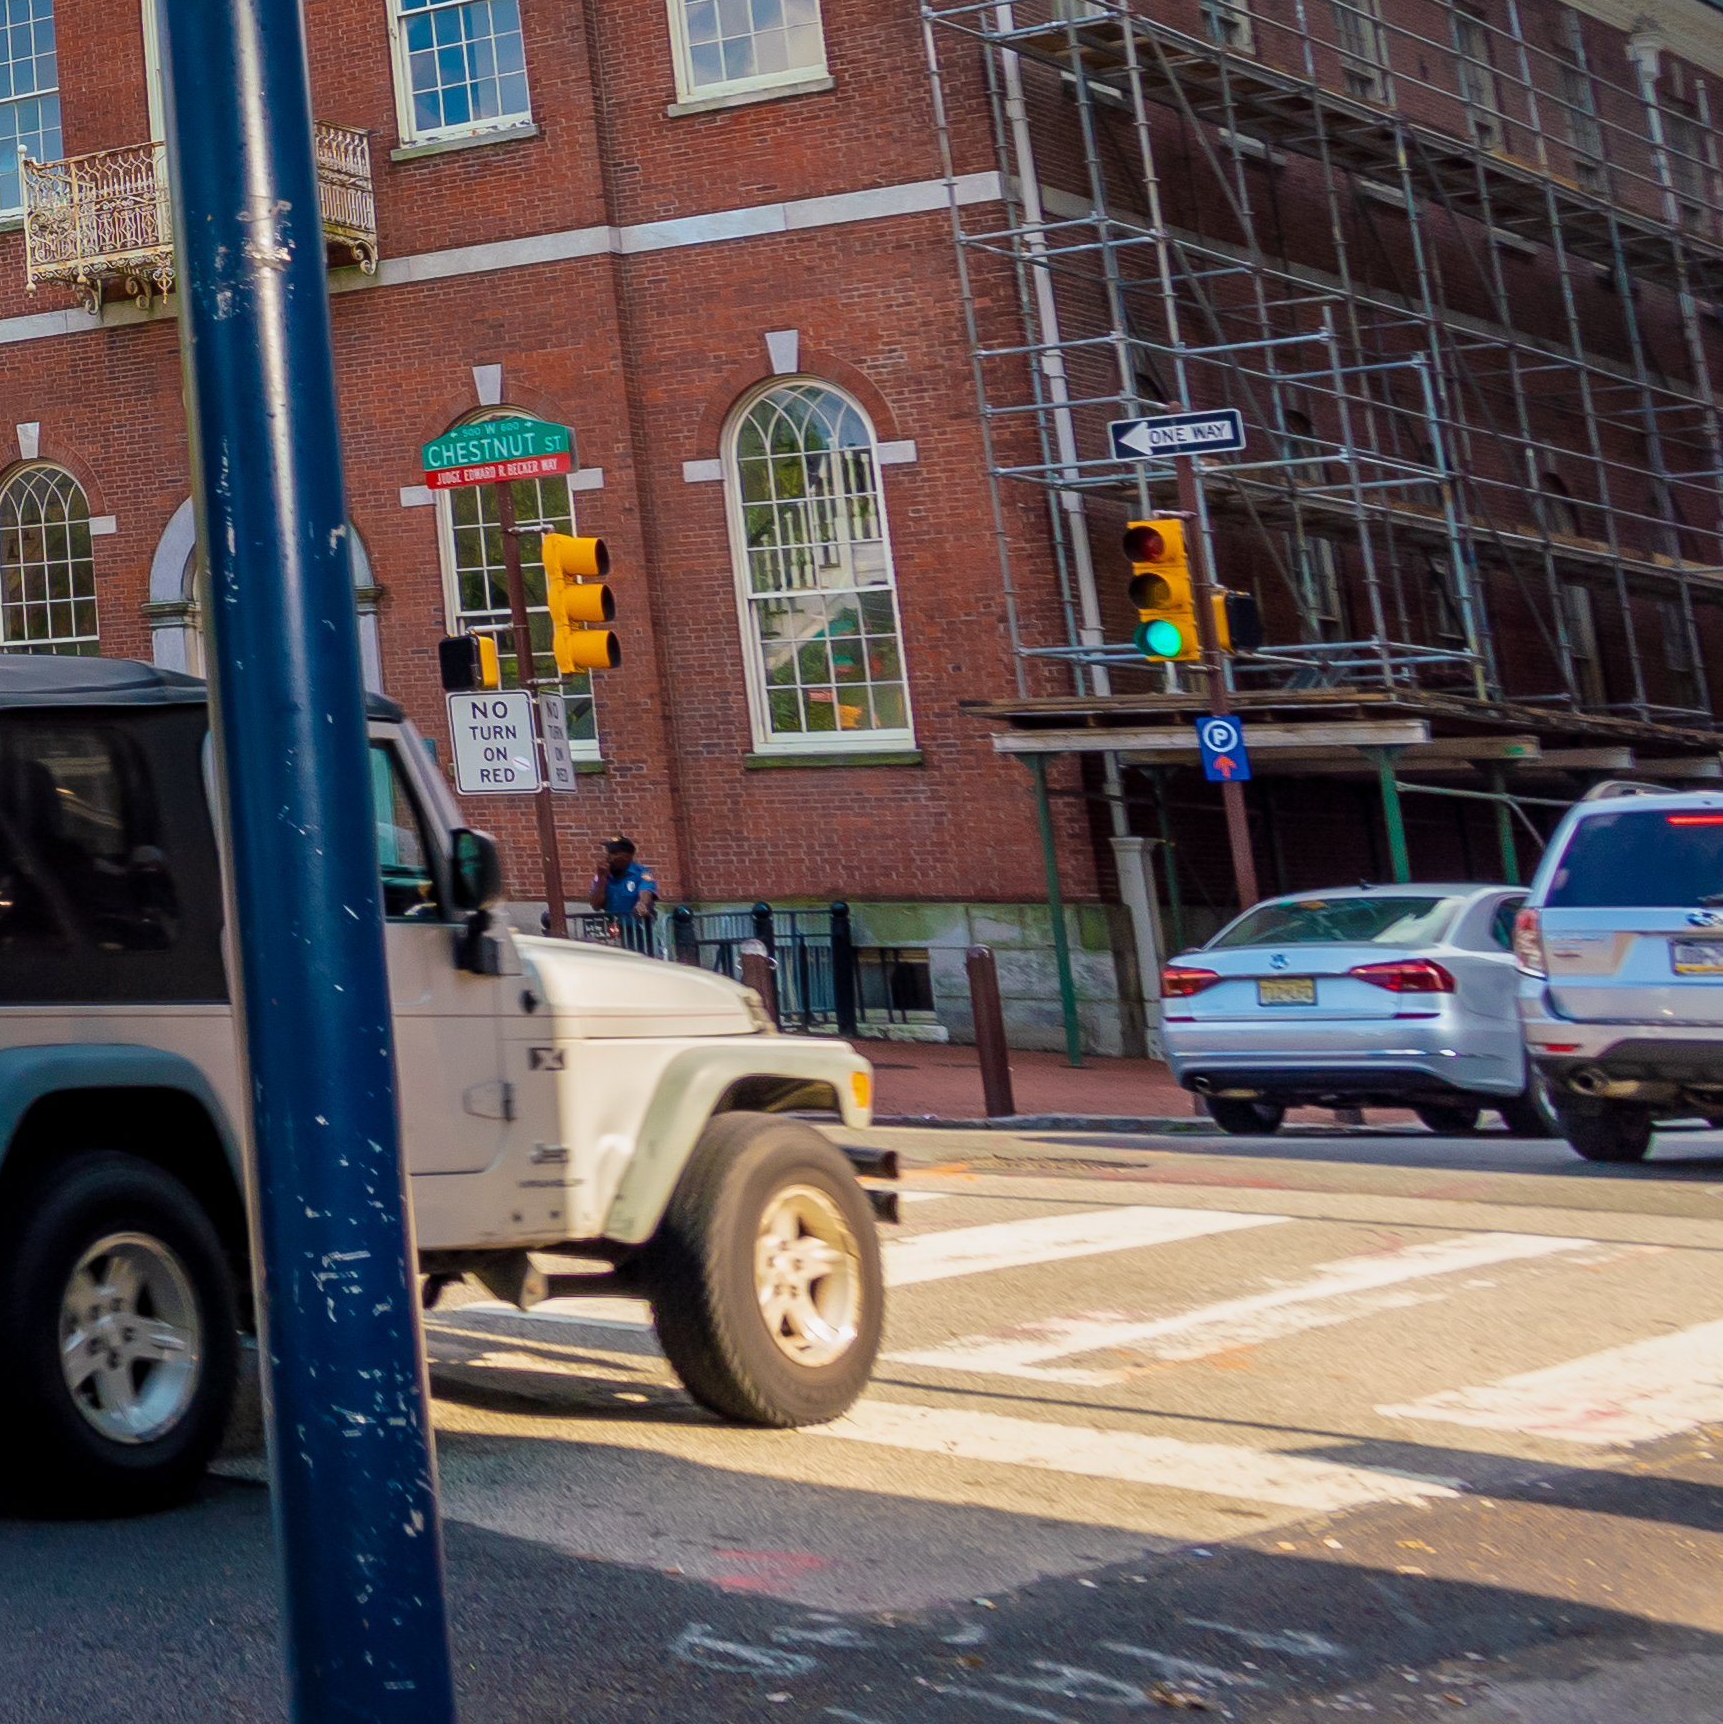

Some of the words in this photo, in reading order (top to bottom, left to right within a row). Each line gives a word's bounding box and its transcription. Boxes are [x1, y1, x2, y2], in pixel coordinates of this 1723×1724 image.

[1149, 427, 1187, 444] ONE
[1190, 423, 1226, 439] WAY
[428, 433, 535, 466] CHESTNUT
[544, 435, 561, 451] ST
[471, 701, 508, 719] NO
[469, 725, 517, 740] TURN
[484, 746, 508, 762] ON
[480, 768, 515, 783] RED
